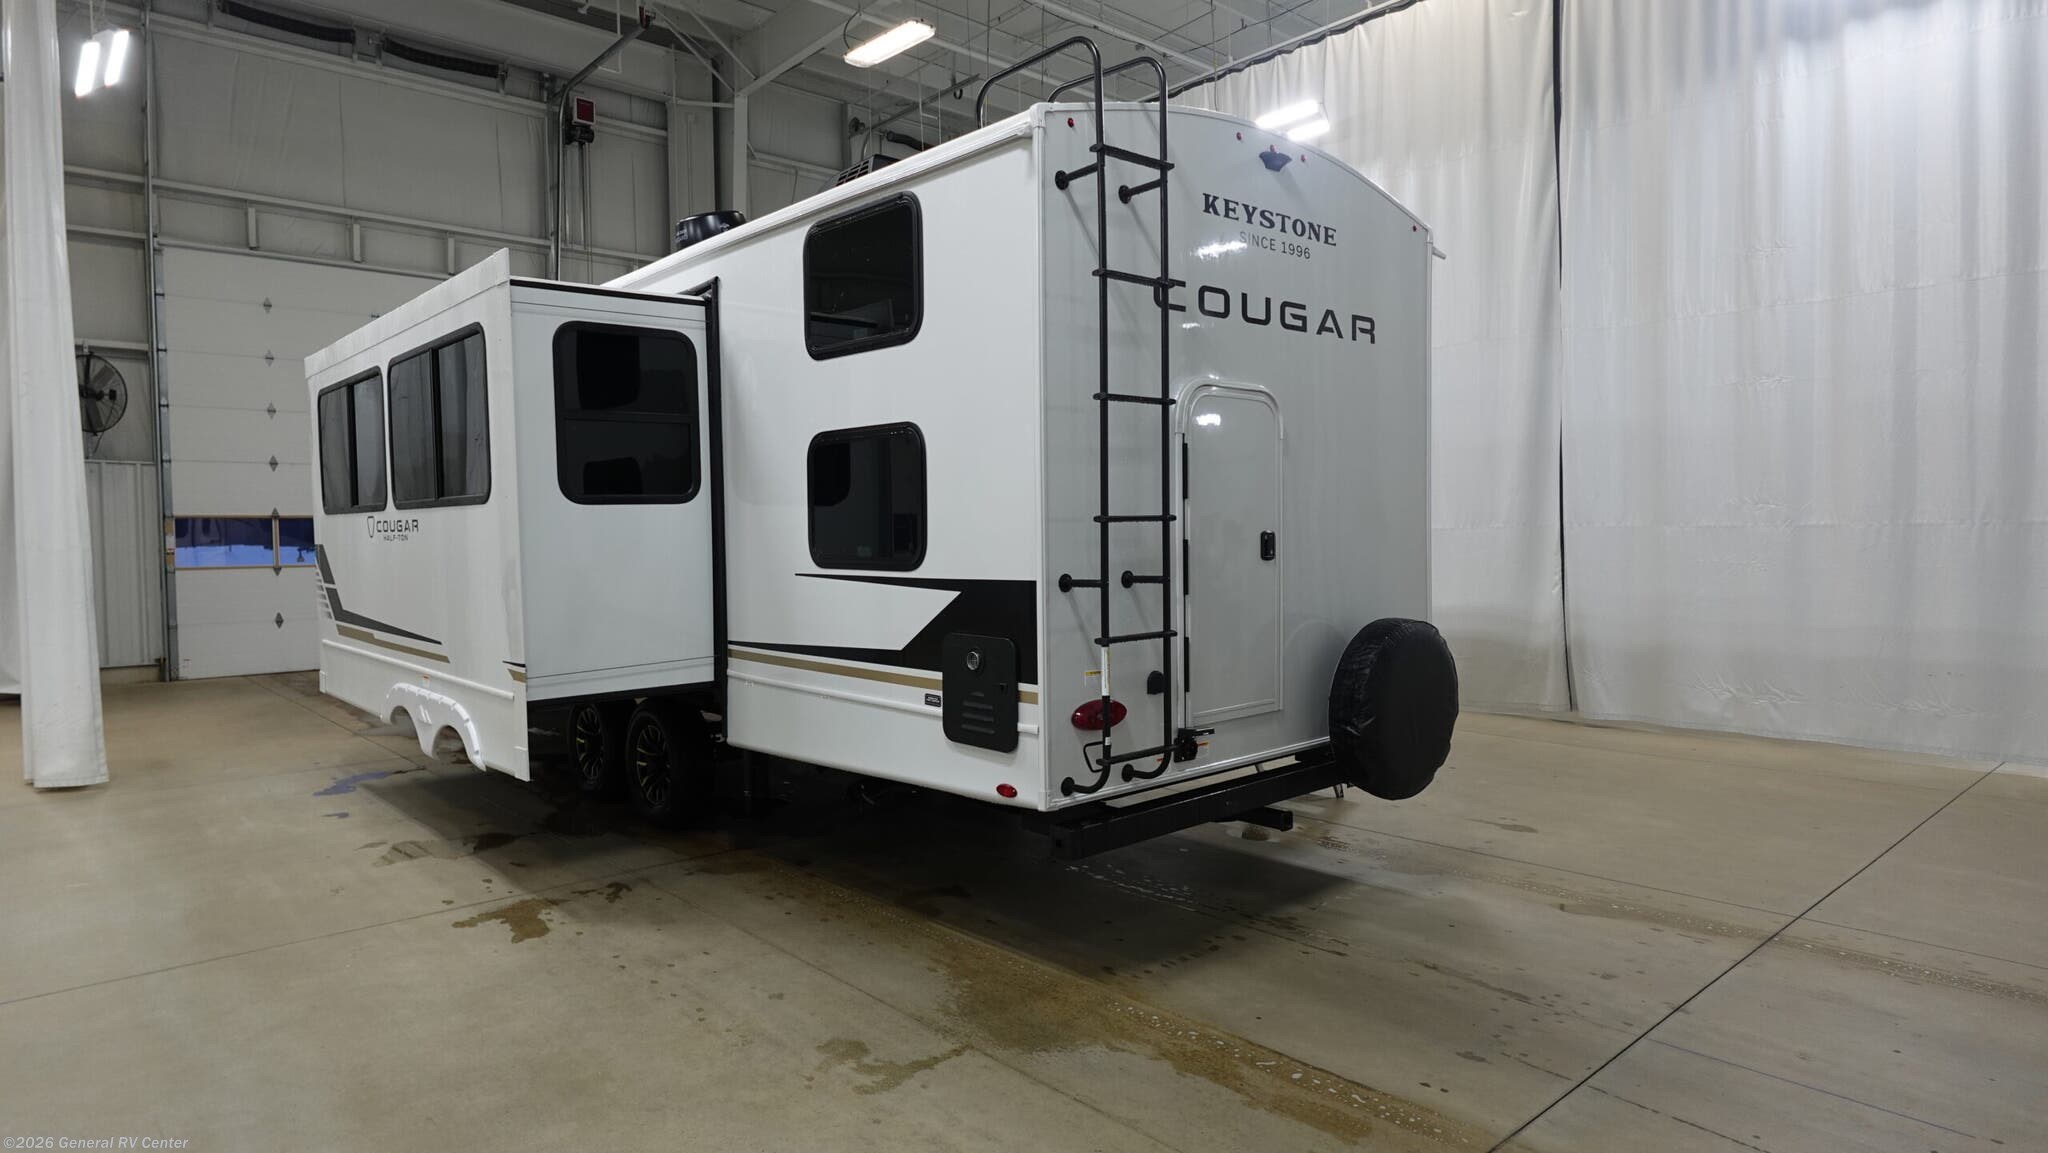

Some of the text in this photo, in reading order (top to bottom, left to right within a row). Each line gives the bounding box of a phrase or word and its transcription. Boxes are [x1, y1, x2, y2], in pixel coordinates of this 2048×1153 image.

[1202, 192, 1337, 247] KEYSTONE
[1239, 231, 1311, 260] SINCE 1996
[1153, 276, 1376, 344] COUGAR
[376, 519, 419, 533] COUGAR
